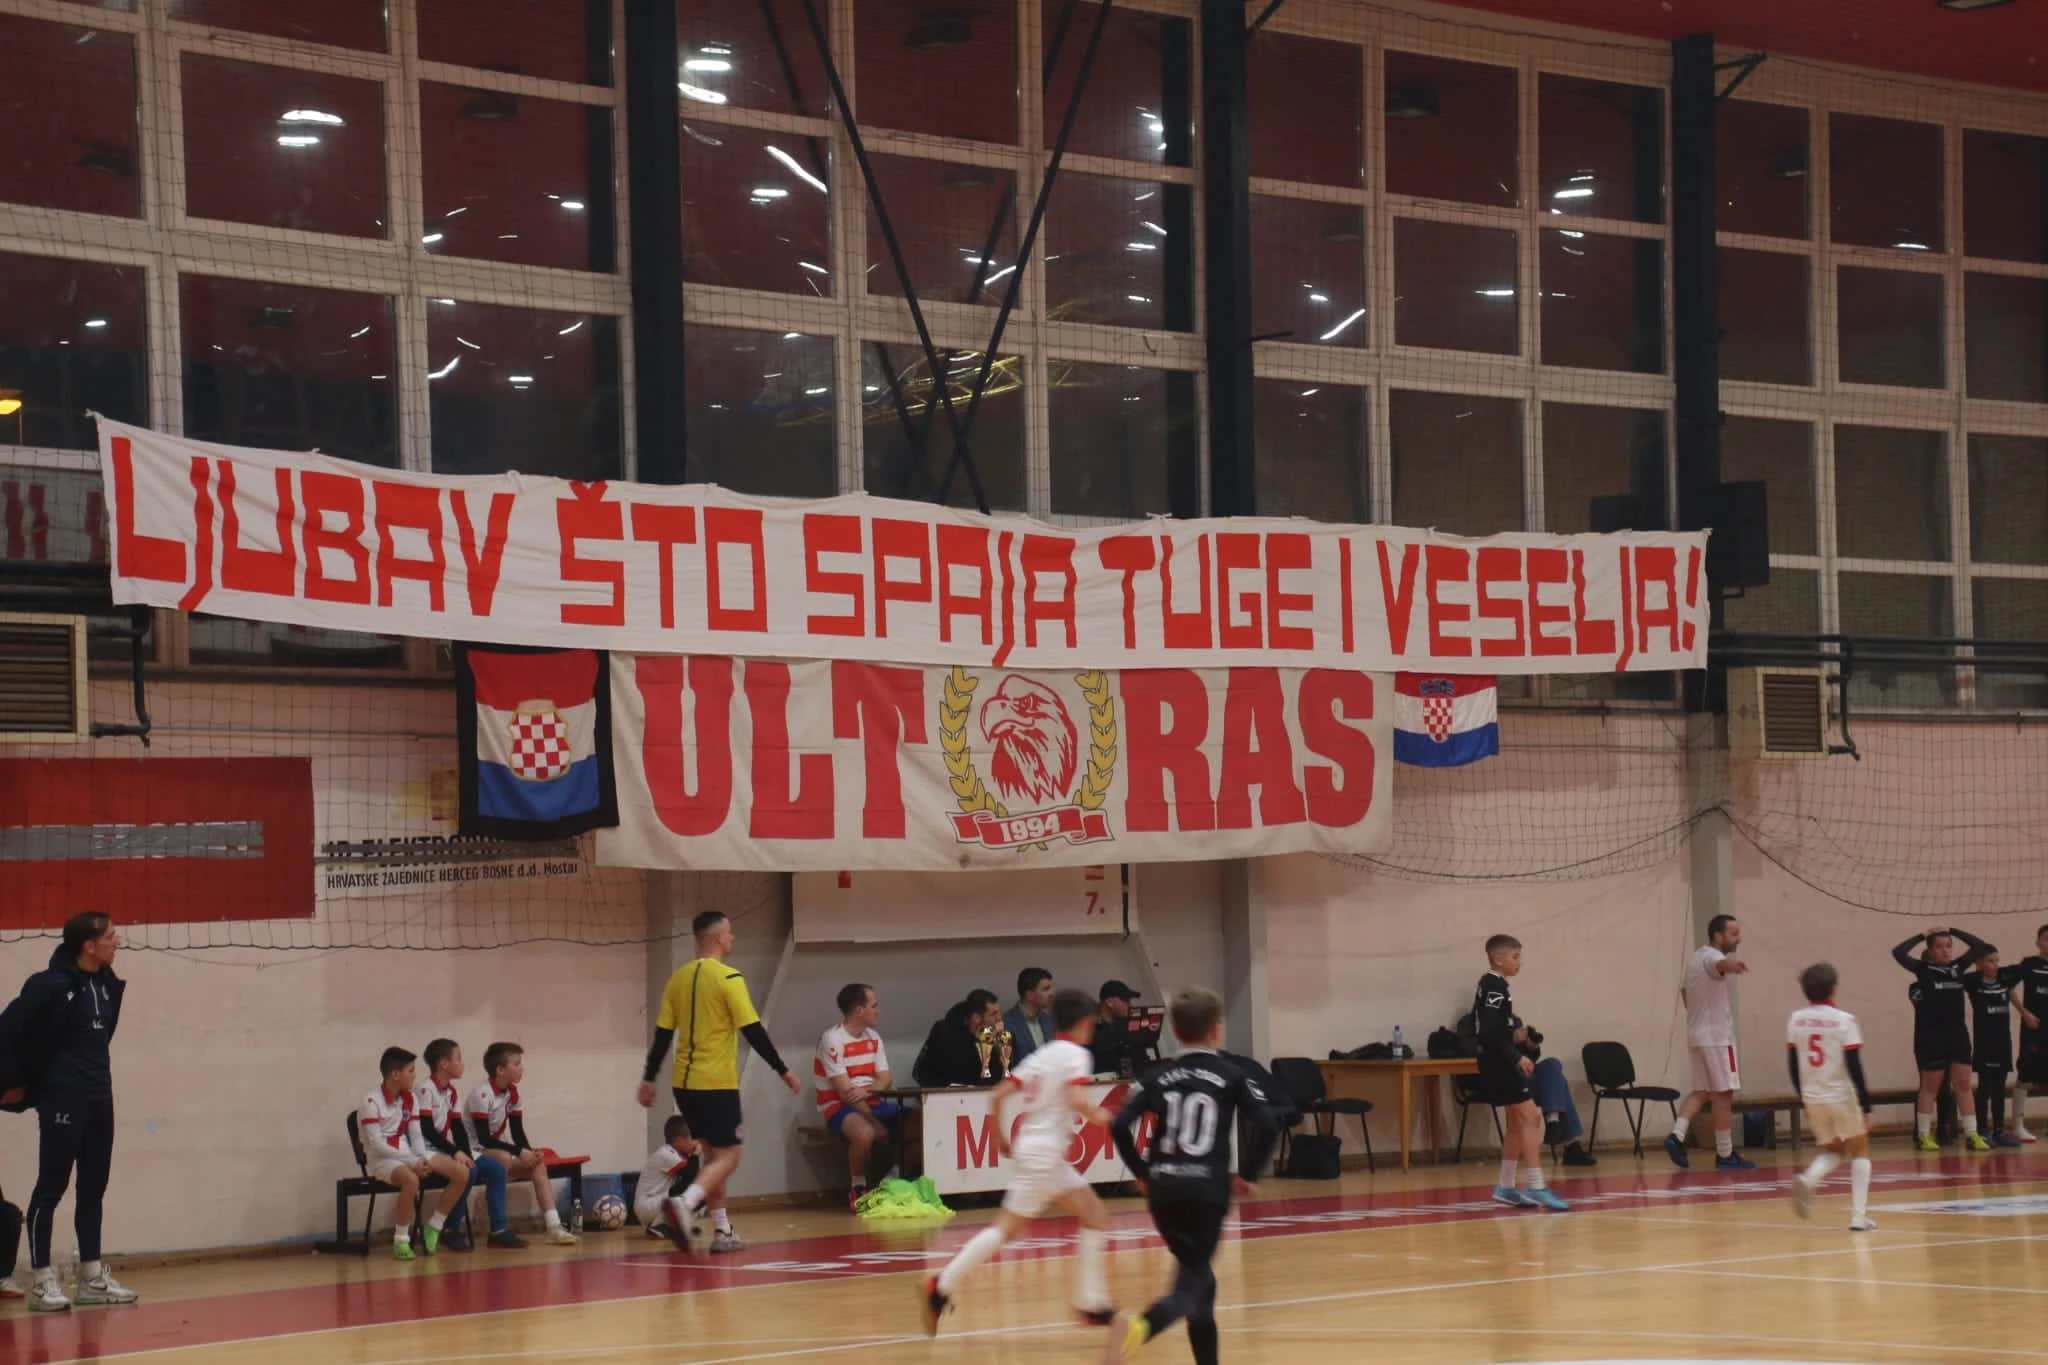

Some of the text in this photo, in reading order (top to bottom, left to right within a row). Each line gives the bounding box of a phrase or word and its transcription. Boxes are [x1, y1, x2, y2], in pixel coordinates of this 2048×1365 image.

[111, 436, 515, 617] LJUBAV
[556, 480, 768, 633] ŠTO
[803, 513, 1077, 668] SPAJA
[1098, 533, 1314, 650] TUGE
[1338, 538, 1354, 653] I
[1376, 540, 1700, 672] VESELJA!
[1000, 812, 1060, 843] 1994
[327, 871, 379, 889] HRVATSKE
[382, 868, 435, 886] ZAJEDNICE
[439, 866, 479, 882] HERCEG
[482, 863, 515, 879] BOSNE
[1807, 1033, 1825, 1068] 5
[1160, 1090, 1219, 1157] 10
